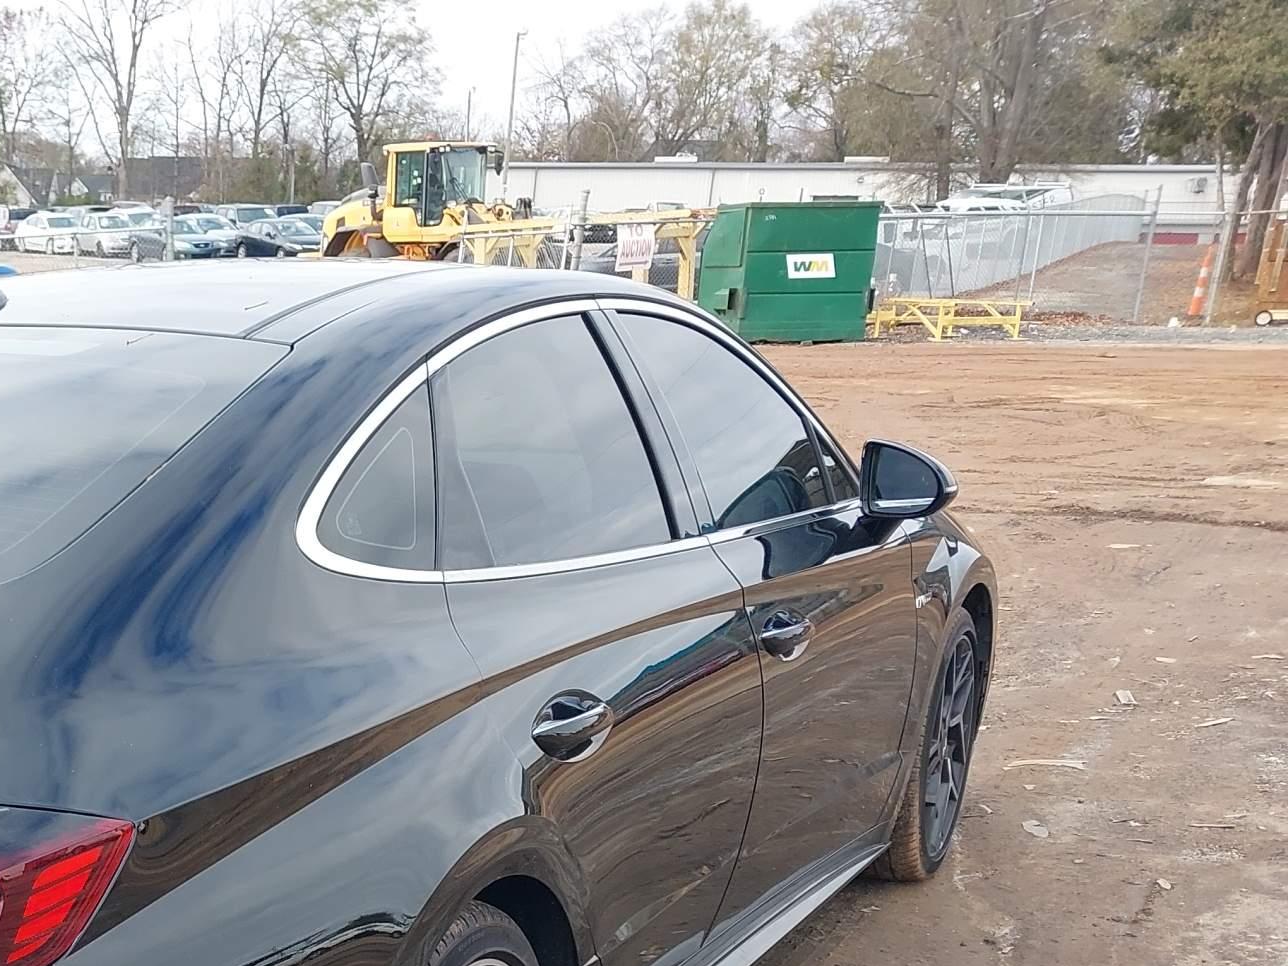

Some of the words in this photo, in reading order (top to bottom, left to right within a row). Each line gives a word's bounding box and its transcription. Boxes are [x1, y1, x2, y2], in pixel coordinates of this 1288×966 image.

[626, 224, 643, 237] TO
[620, 239, 652, 258] AUCTION
[793, 261, 829, 272] WM
